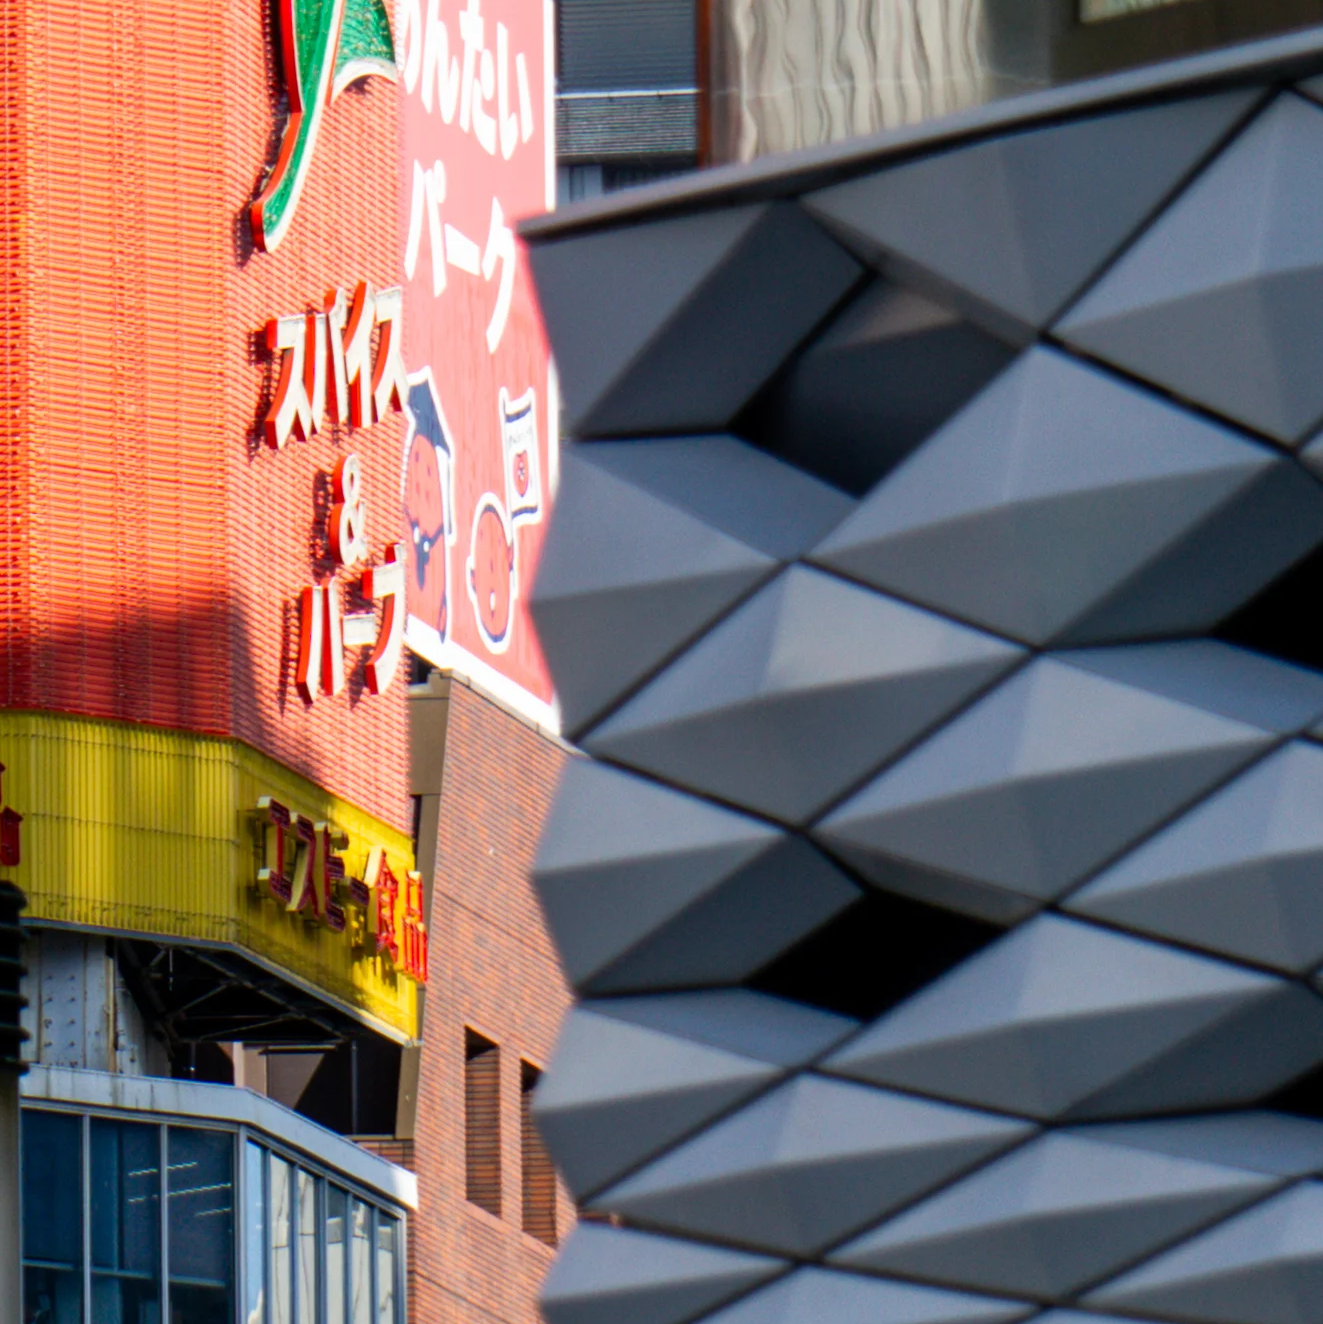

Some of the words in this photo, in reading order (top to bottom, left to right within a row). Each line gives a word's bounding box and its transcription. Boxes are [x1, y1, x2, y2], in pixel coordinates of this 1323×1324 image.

[404, 159, 516, 354] パーク
[266, 280, 409, 449] スパイス
[330, 453, 367, 566] &
[297, 542, 406, 705] ハーブ
[257, 795, 428, 982] エスビー食品
